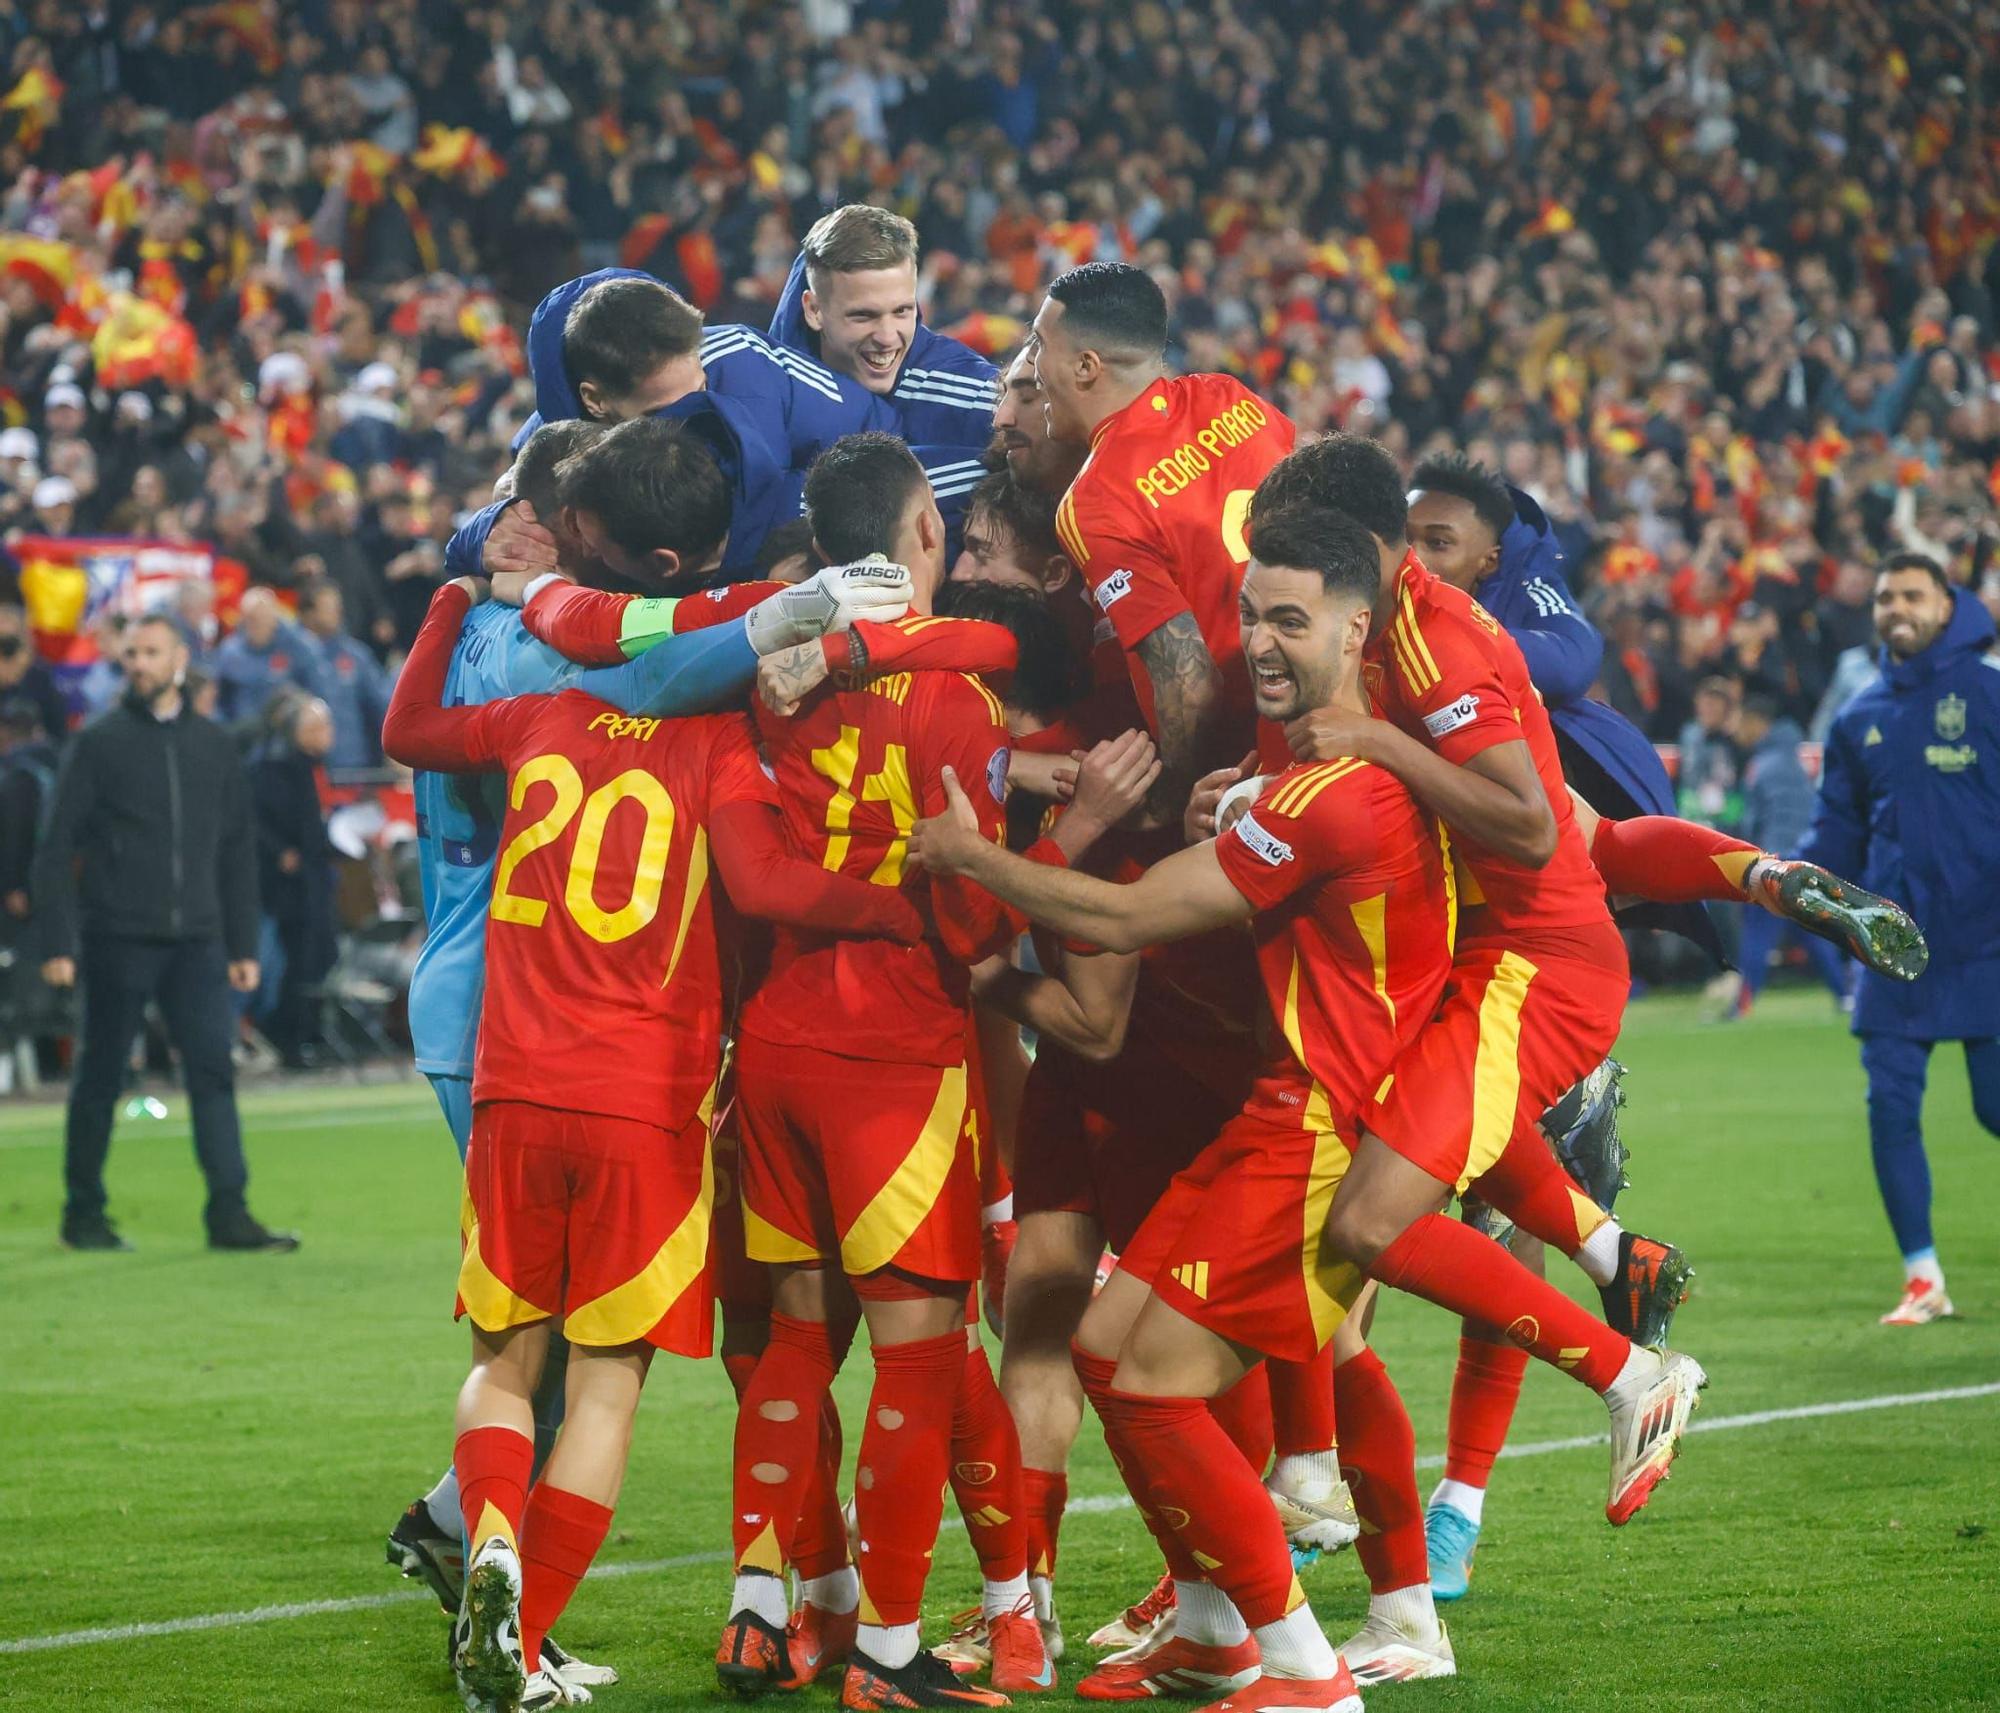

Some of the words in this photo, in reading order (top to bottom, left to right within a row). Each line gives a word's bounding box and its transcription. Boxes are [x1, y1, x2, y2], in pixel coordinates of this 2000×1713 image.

[1136, 444, 1210, 508] PEDRO
[1198, 400, 1266, 458] PORRO
[841, 566, 905, 580] reusch
[1107, 578, 1125, 593] 10
[1452, 703, 1471, 718] 10
[811, 724, 919, 886] 11
[490, 754, 675, 943] 20
[1265, 842, 1283, 859] 10
